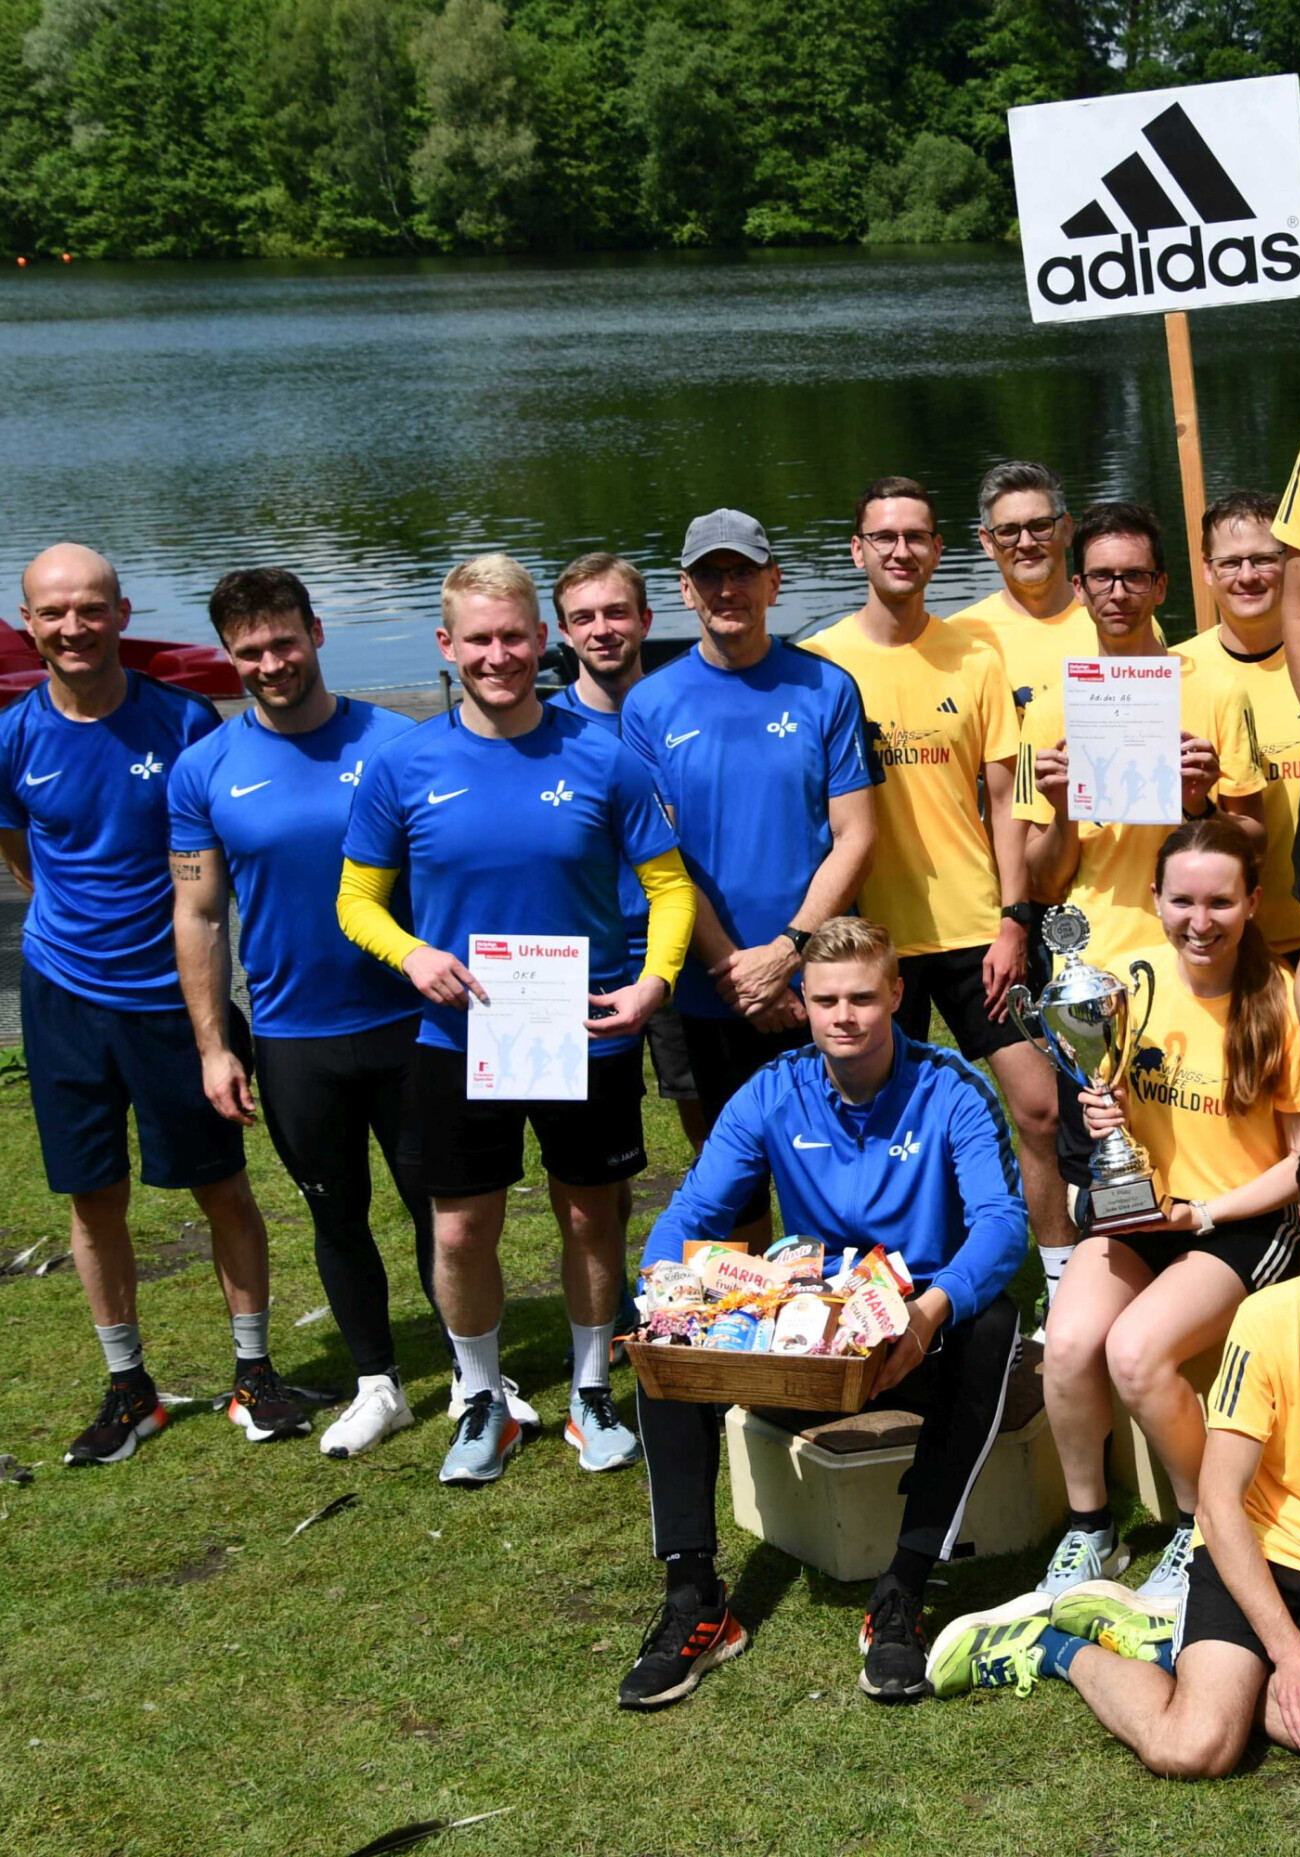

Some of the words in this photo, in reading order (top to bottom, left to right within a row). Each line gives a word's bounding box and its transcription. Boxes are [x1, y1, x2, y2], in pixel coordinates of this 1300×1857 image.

[1110, 665, 1173, 679] Urkunde
[920, 747, 950, 764] RUN
[518, 944, 580, 959] Urkunde
[512, 970, 537, 980] OKE
[1143, 1078, 1201, 1112] WORLD
[1203, 1097, 1232, 1118] RU
